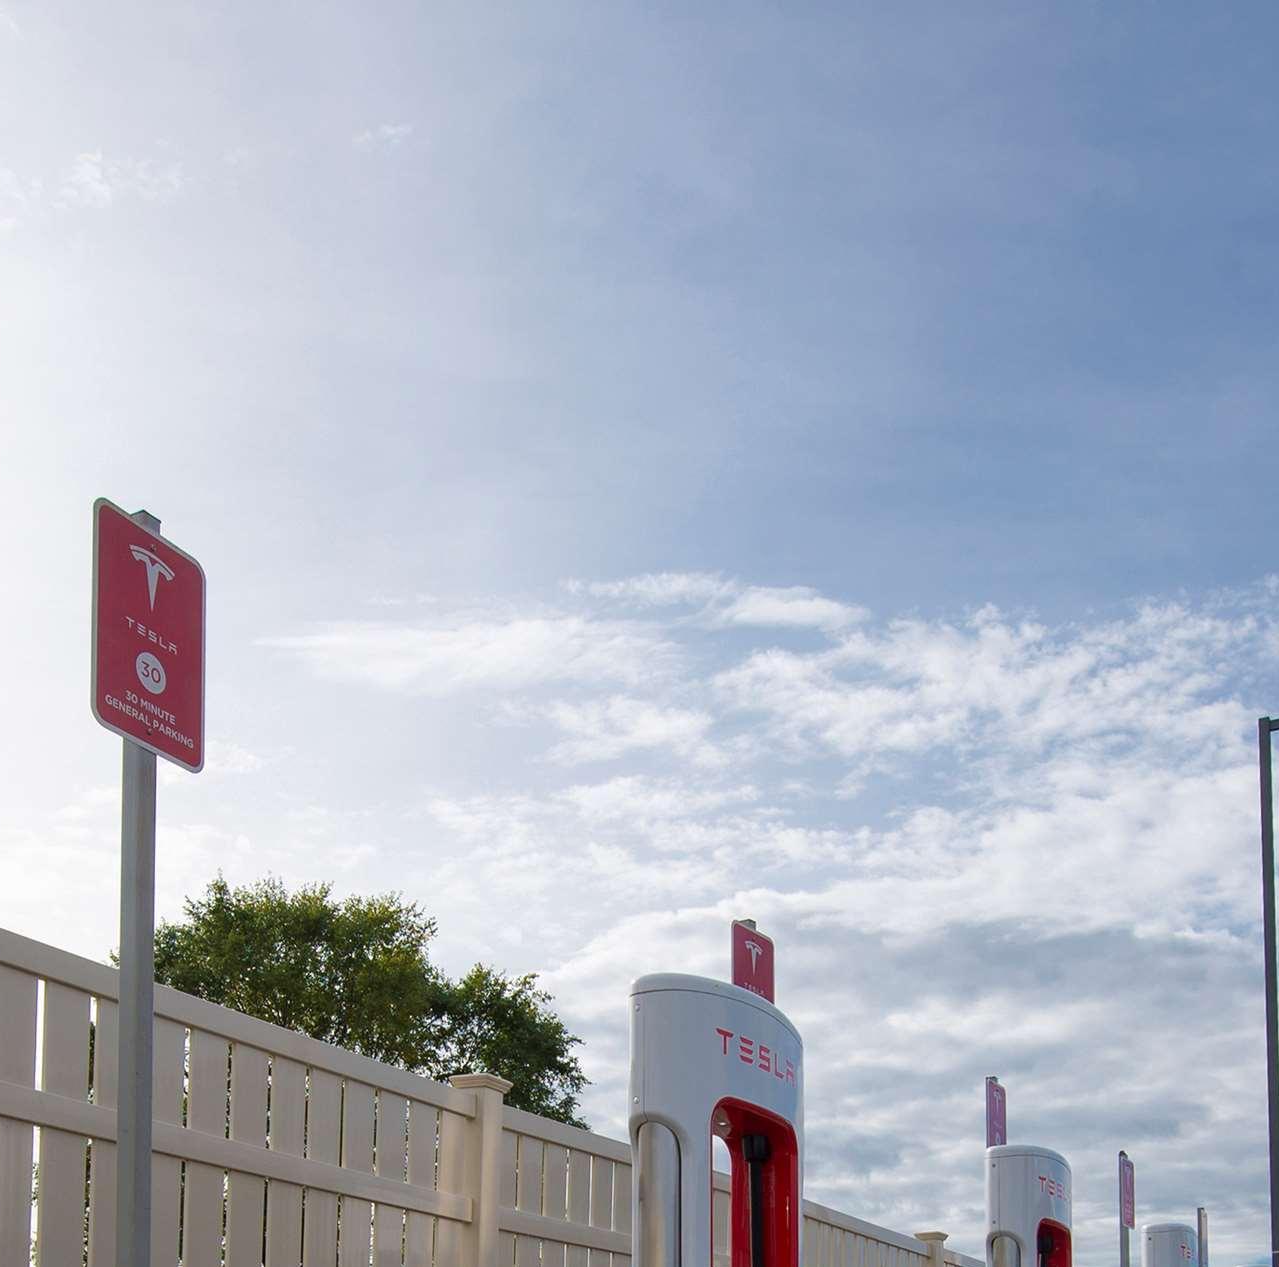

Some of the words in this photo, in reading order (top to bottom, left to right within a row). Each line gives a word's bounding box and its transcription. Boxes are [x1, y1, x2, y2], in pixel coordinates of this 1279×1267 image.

[125, 616, 178, 655] TESLA
[140, 660, 161, 683] 30
[104, 694, 151, 726] GENERAL
[152, 720, 194, 748] PARKING
[125, 690, 138, 704] 30
[140, 698, 176, 725] MINUTE
[715, 1027, 797, 1088] TESLA
